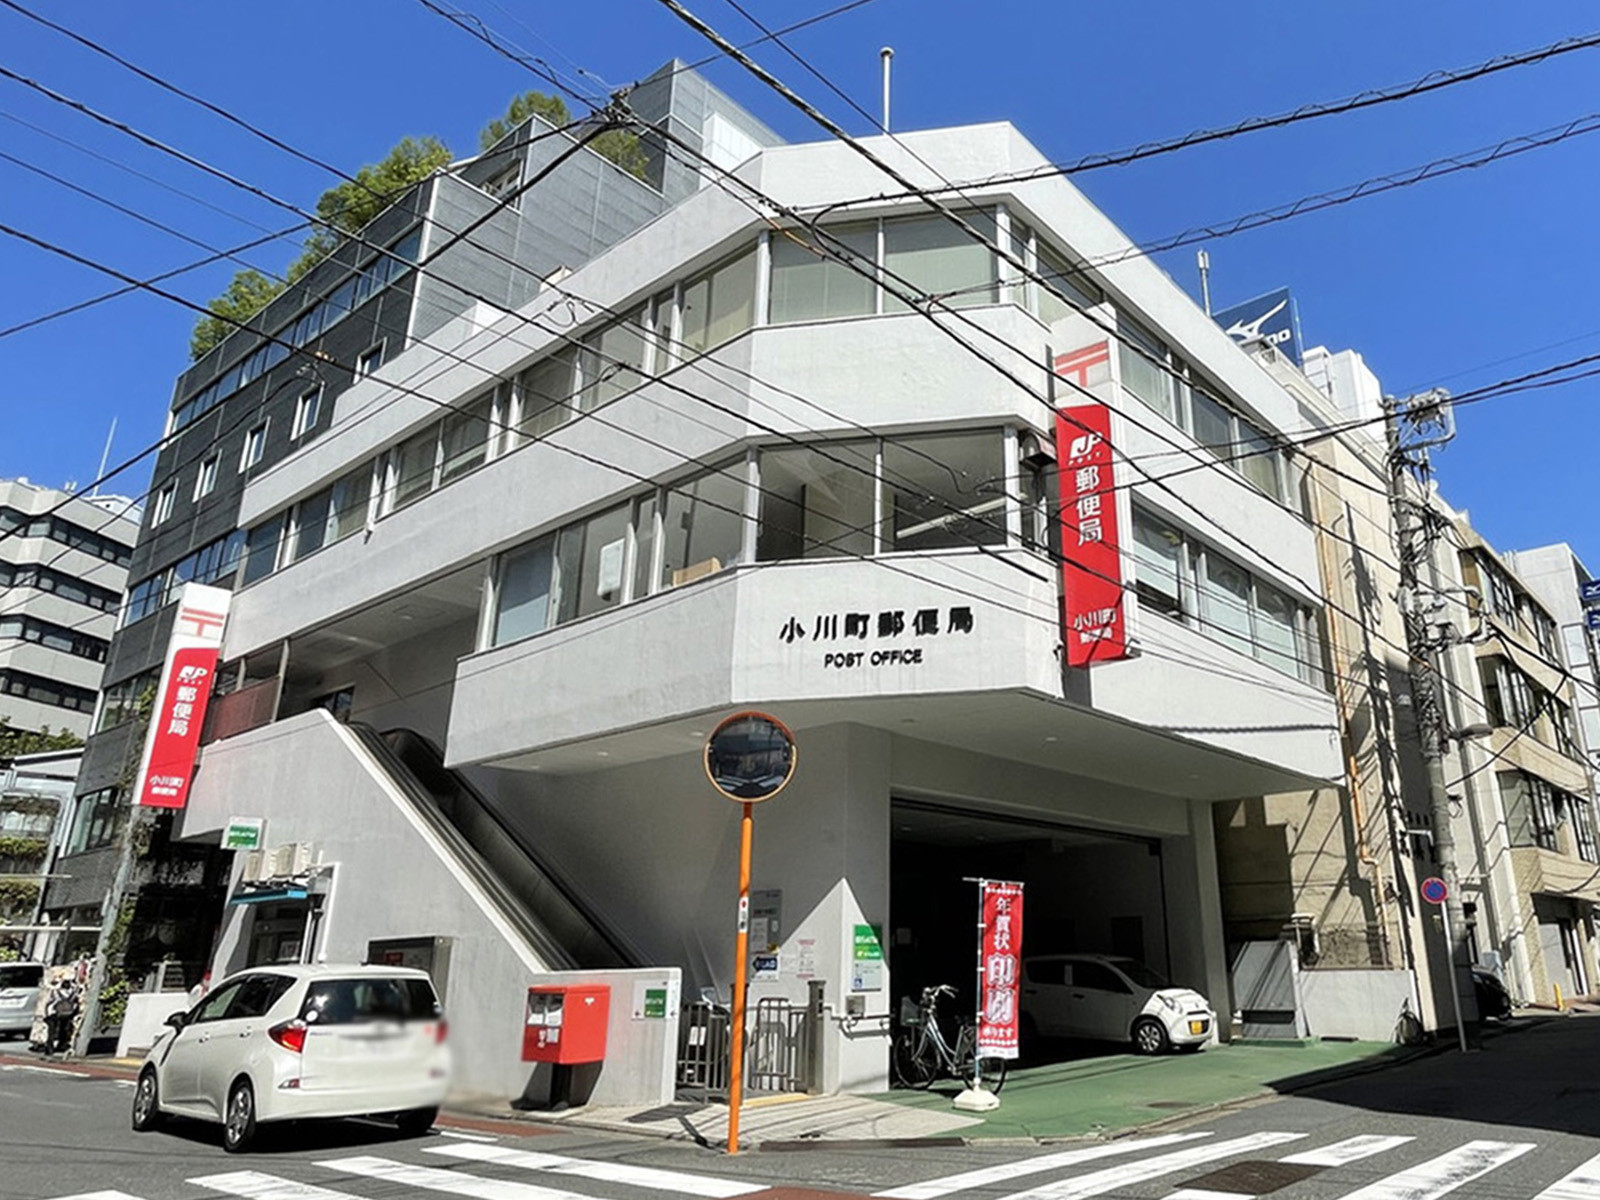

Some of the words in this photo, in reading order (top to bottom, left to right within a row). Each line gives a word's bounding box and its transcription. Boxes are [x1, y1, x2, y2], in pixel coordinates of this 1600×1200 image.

[1075, 465, 1103, 546] 郵便局
[779, 606, 975, 644] 小川町郵便局
[824, 652, 864, 668] POST
[870, 649, 923, 666] OFFICE
[167, 686, 198, 737] 郵便局
